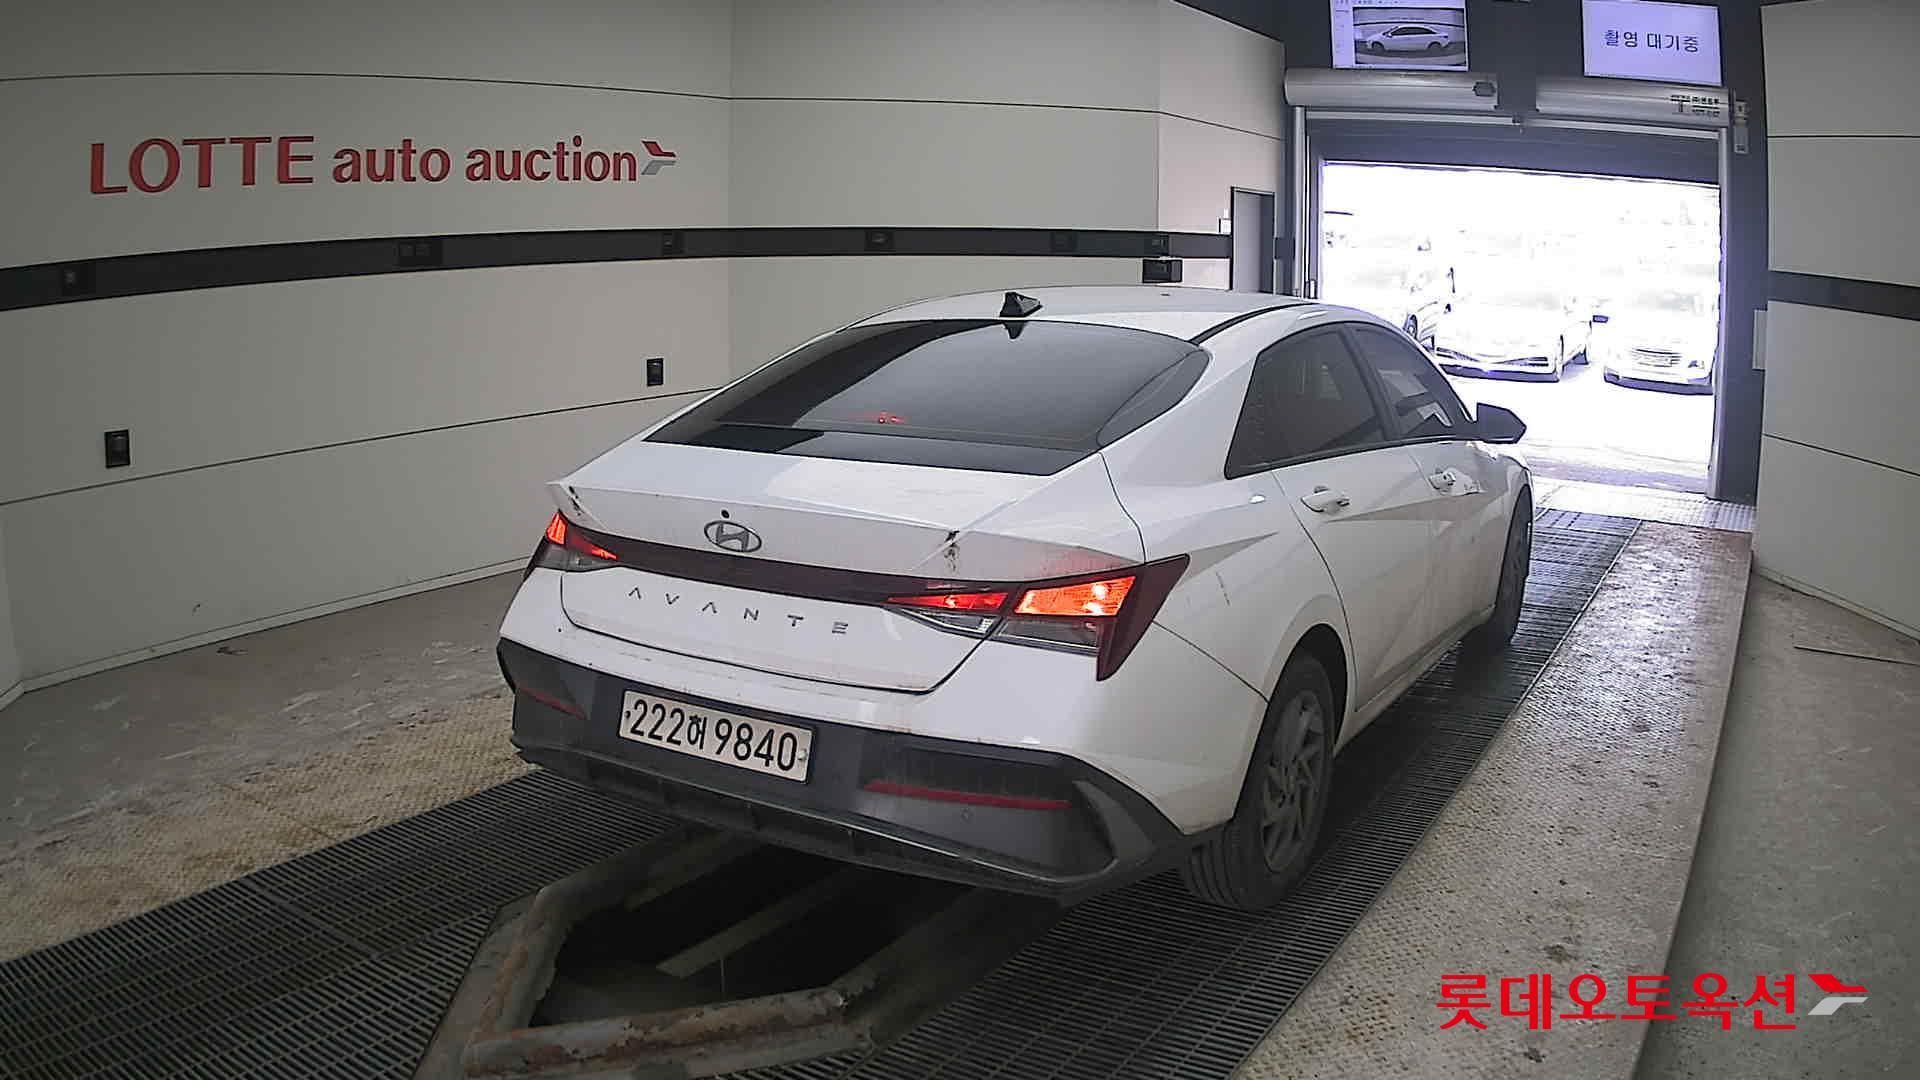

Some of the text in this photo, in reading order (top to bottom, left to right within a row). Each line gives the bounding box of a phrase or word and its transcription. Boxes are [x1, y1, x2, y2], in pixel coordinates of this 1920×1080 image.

[1646, 33, 1698, 53] 대기중
[91, 135, 637, 194] LOTTE auto auction
[628, 587, 849, 634] AVANTE
